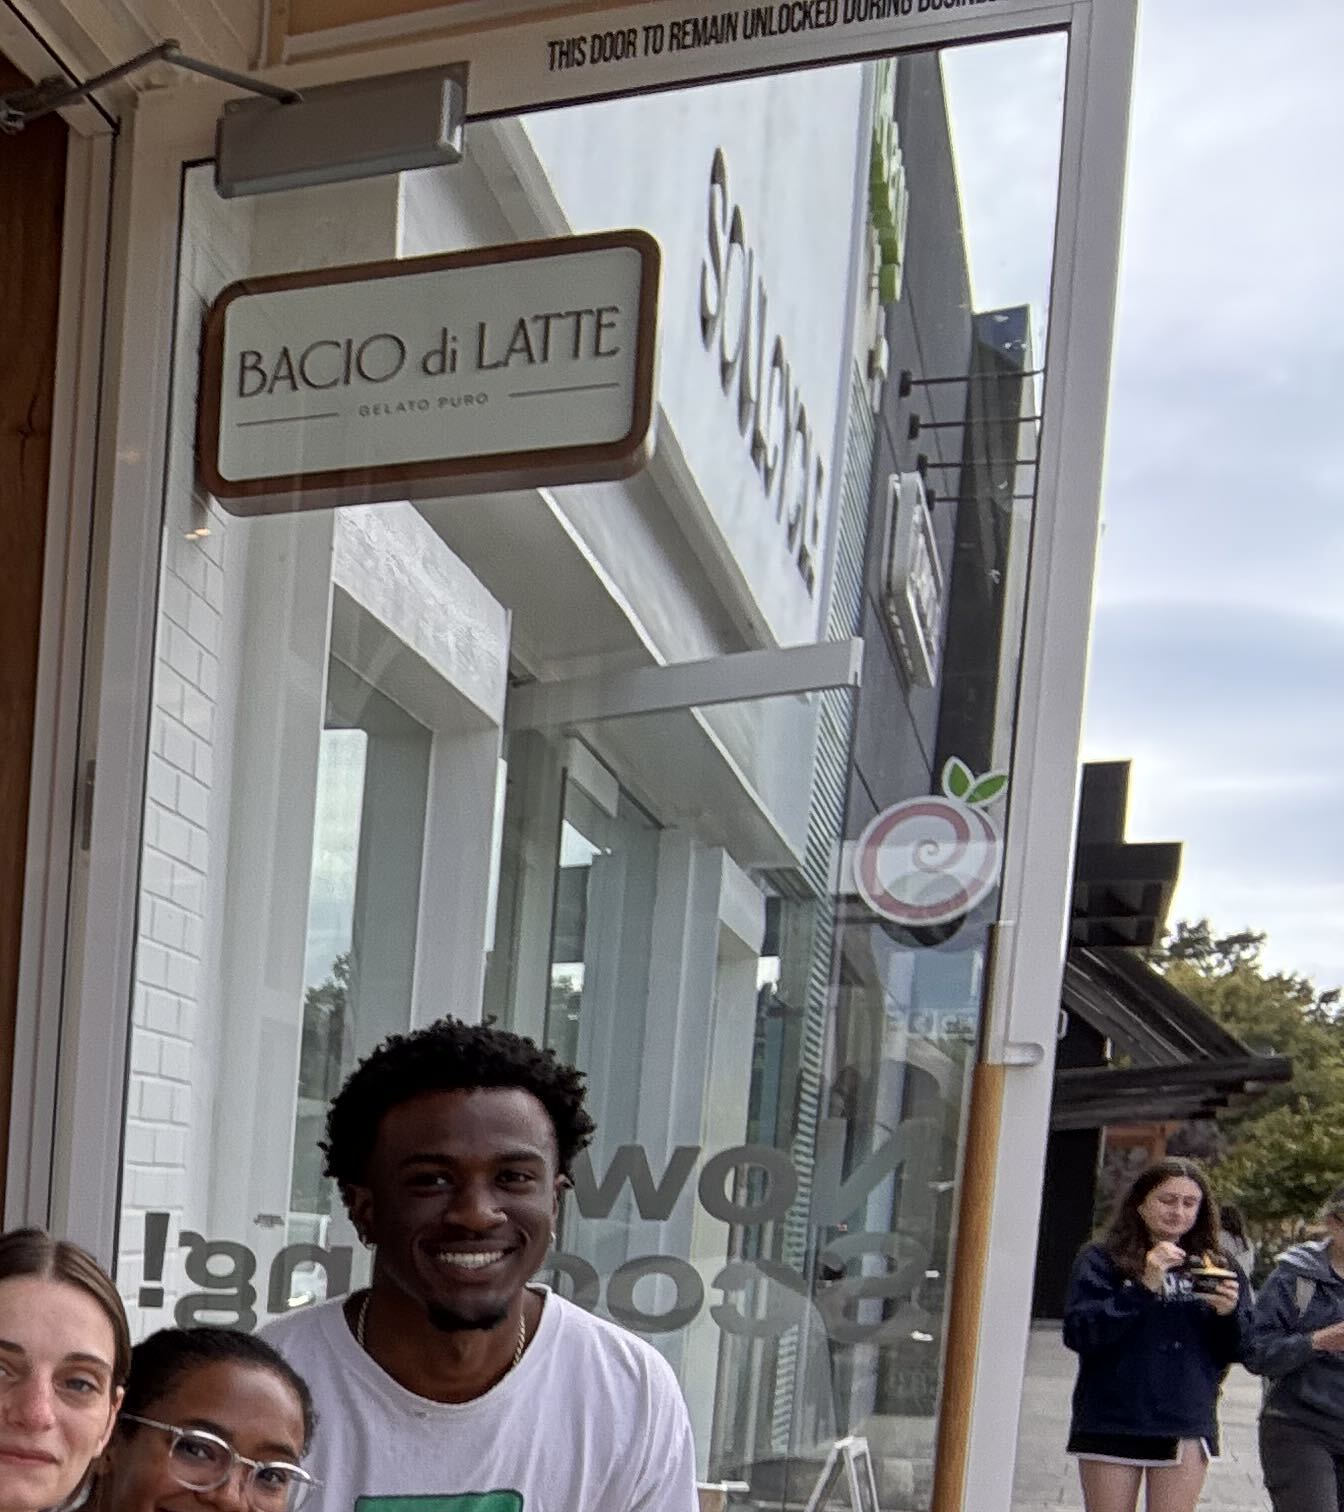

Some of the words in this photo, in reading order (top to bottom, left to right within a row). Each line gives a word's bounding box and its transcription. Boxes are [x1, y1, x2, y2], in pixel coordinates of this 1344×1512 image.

[547, 36, 587, 71] THIS
[589, 28, 637, 64] DOOR
[642, 24, 664, 56] TO
[669, 12, 739, 52] REMAIN
[743, 0, 838, 40] UNLOCKED
[238, 333, 406, 398] BACIO
[421, 327, 458, 377] di
[476, 306, 621, 371] LATTE
[359, 399, 430, 417] GELATO
[437, 391, 489, 409] PURO
